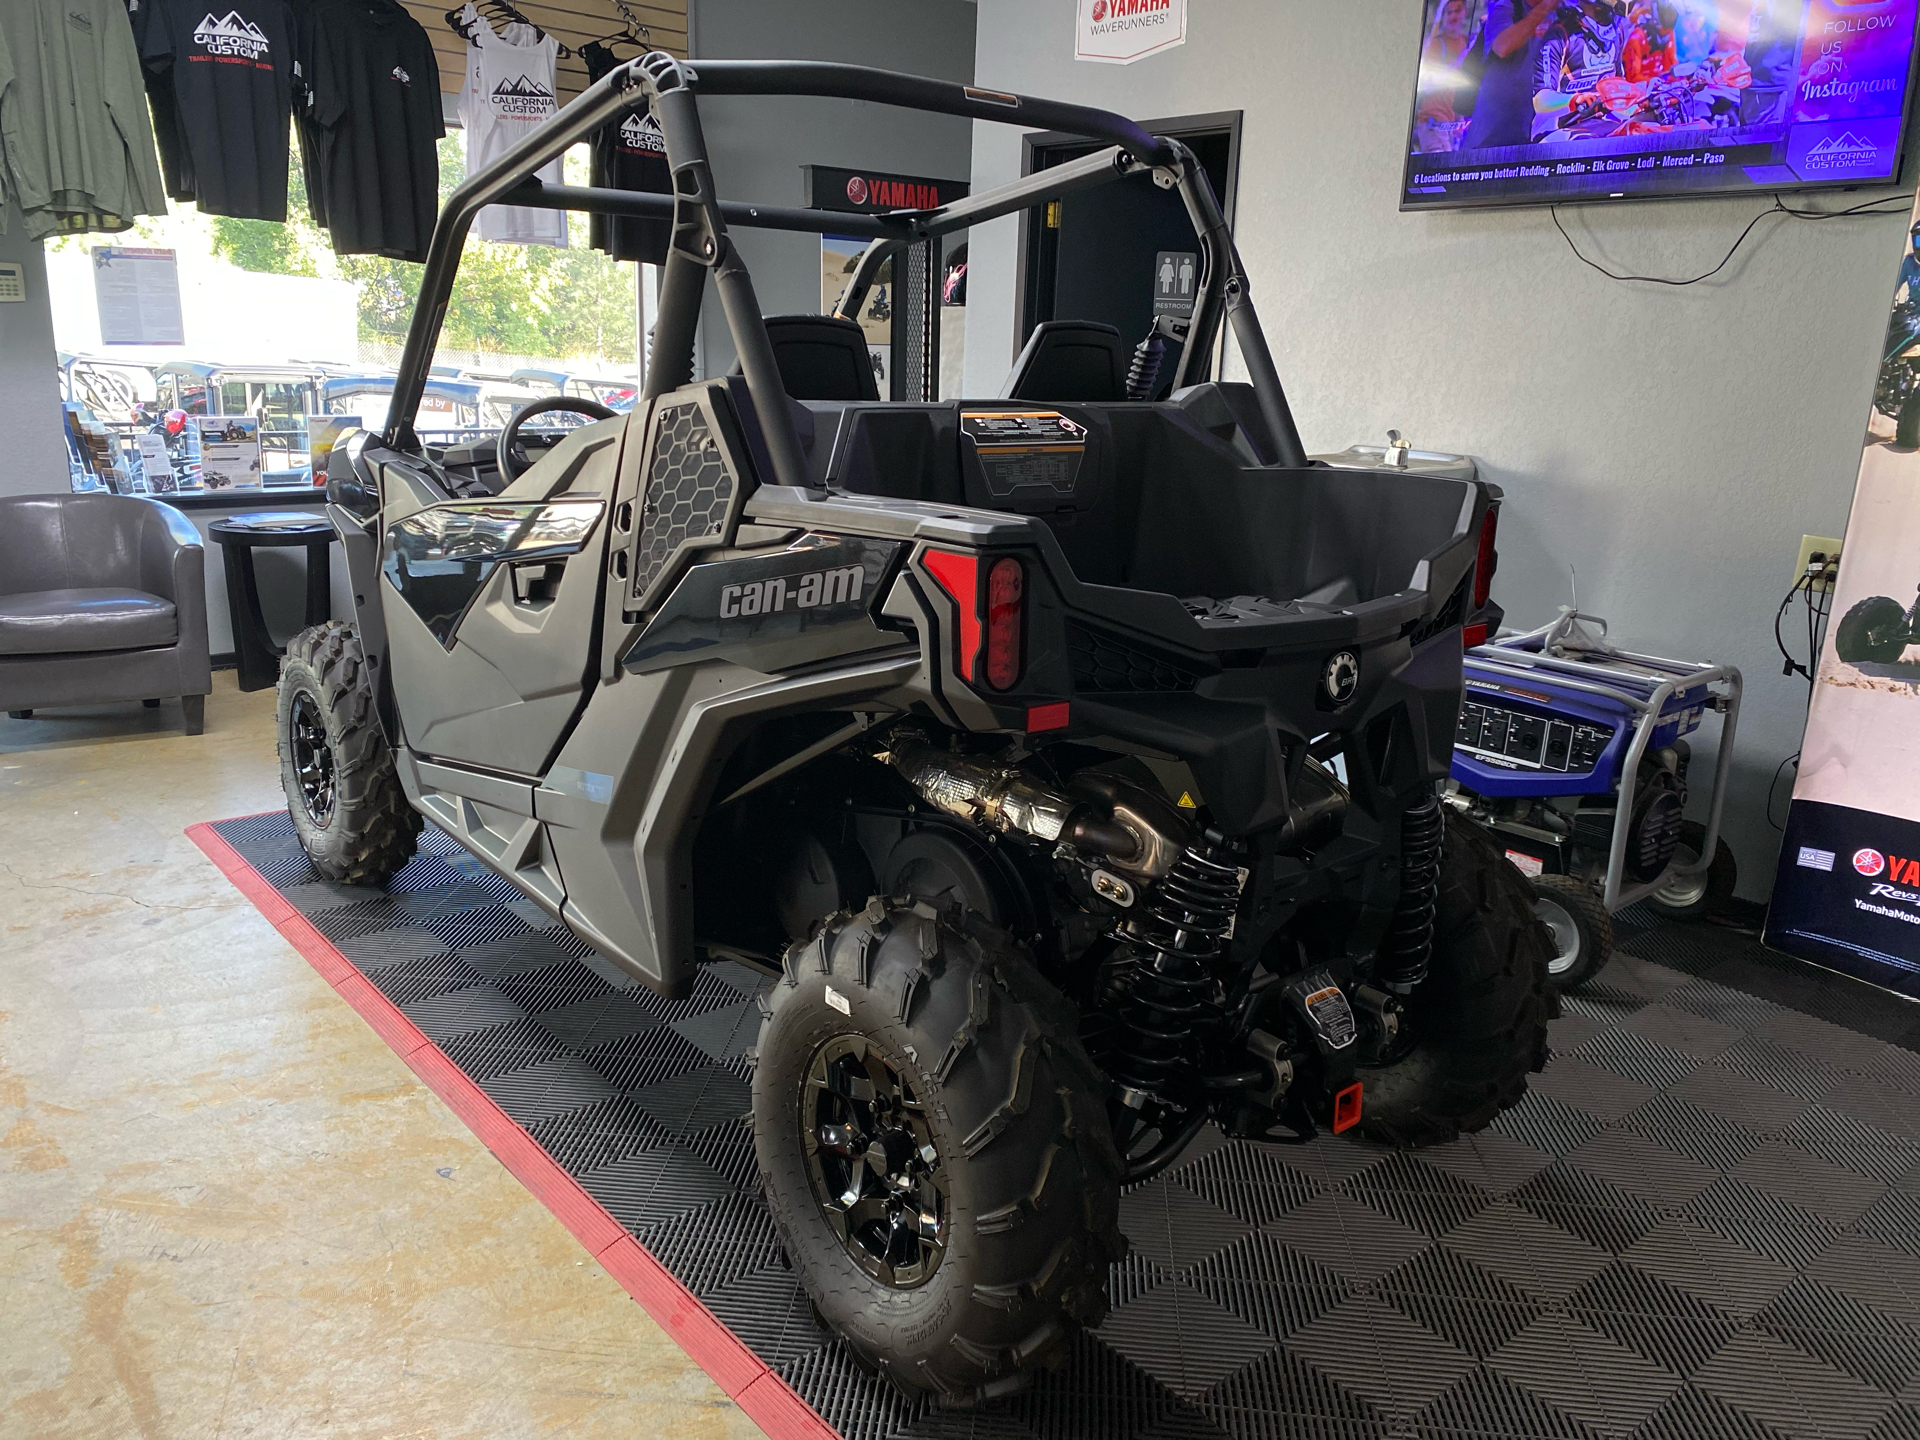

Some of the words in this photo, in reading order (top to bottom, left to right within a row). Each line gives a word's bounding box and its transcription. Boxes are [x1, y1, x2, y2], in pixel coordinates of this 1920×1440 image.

[1824, 14, 1897, 34] FOLLOW
[193, 34, 269, 53] CALIFORNIA
[1821, 41, 1842, 55] US
[207, 44, 259, 60] CUSTOM
[1818, 61, 1843, 75] ON
[1801, 77, 1899, 103] Instagram
[491, 96, 555, 106] CALIFORNIA
[502, 104, 547, 114] CUSTOM
[620, 130, 665, 144] CALIFORN
[626, 139, 667, 153] CUSTOM
[1805, 151, 1877, 163] CALIFORNIA
[1414, 174, 1419, 184] 6
[1420, 172, 1451, 184] Locations
[1452, 171, 1460, 182] to
[1460, 171, 1479, 181] serve
[1480, 169, 1493, 182] you
[1494, 167, 1518, 179] better!
[1519, 165, 1550, 177] Redding
[1556, 163, 1585, 175] Rocklin
[1592, 161, 1605, 172] Elk
[1606, 159, 1629, 171] Grove
[1637, 157, 1655, 169] Lodi
[1662, 154, 1694, 167] Merced
[1703, 152, 1725, 164] Paso
[1805, 160, 1856, 170] CUSTOM
[869, 179, 939, 210] YAMAHA
[435, 398, 446, 410] by
[719, 564, 865, 619] can-am
[1471, 681, 1501, 691] YAMAHA
[1800, 853, 1815, 861] USA
